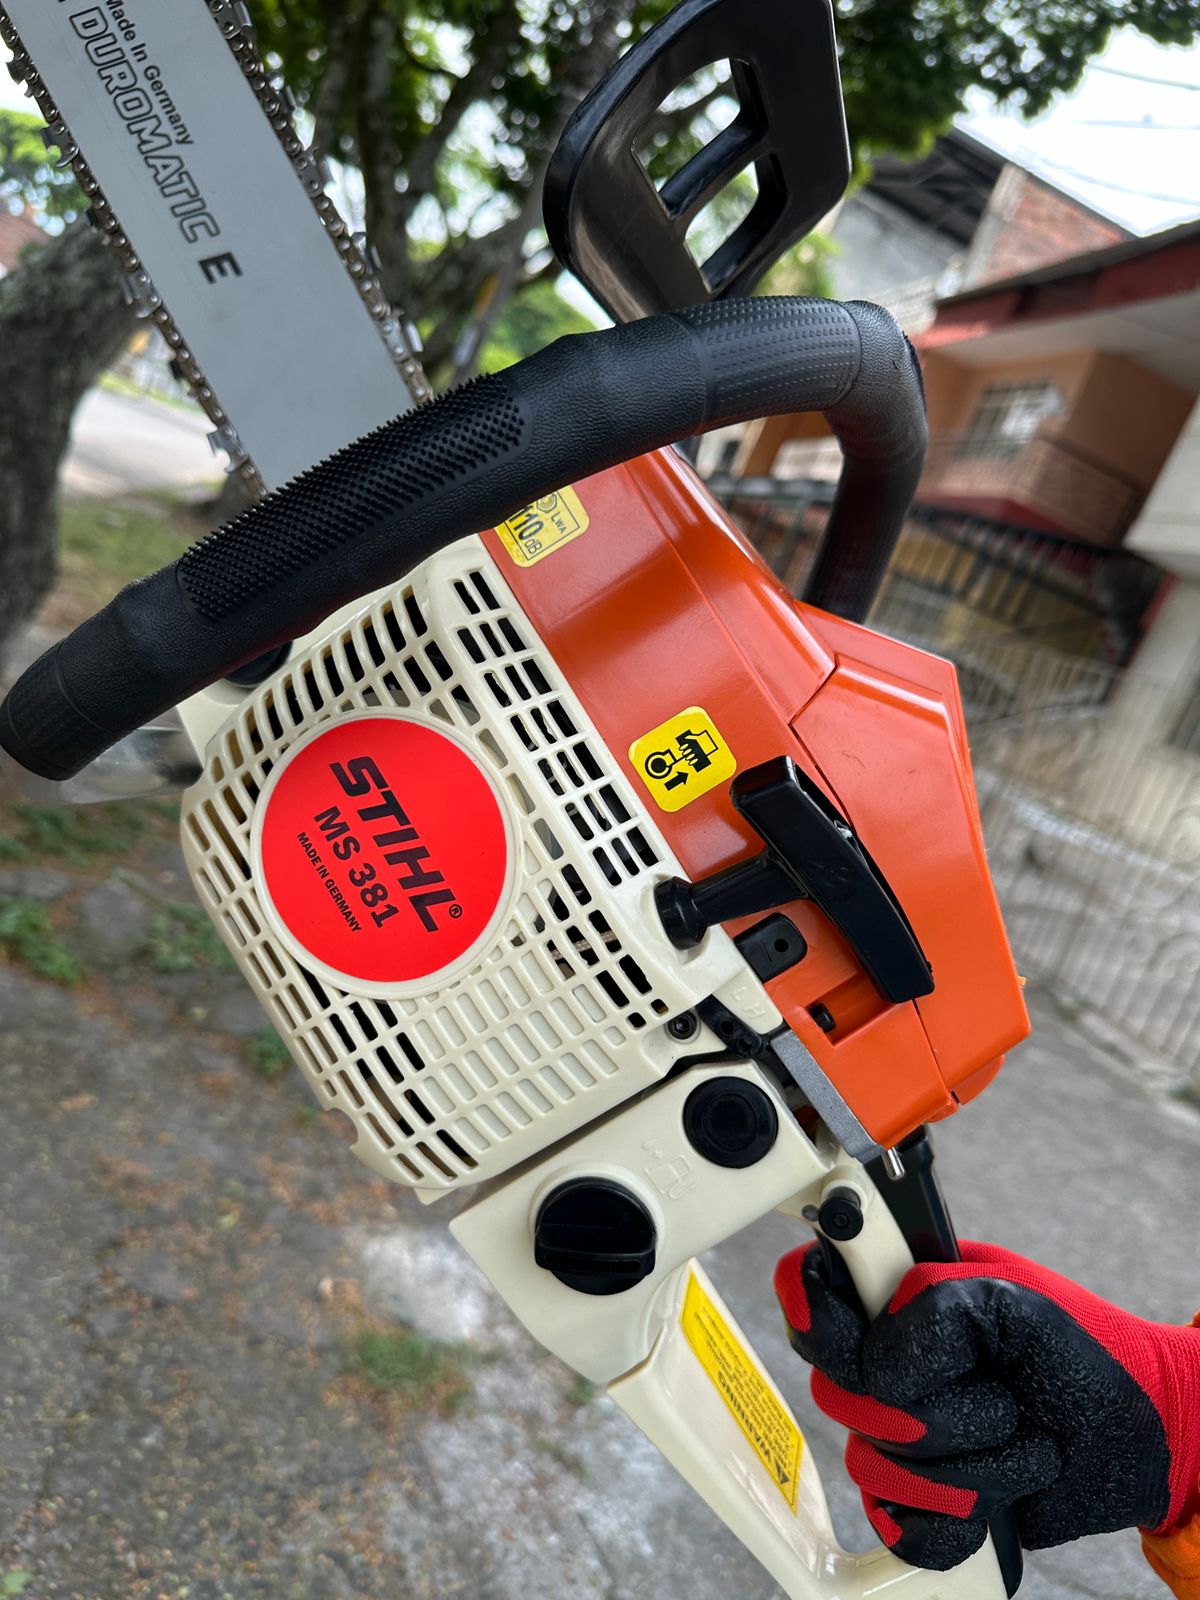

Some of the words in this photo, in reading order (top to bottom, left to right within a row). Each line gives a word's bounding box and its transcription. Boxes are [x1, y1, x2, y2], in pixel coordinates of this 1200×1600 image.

[68, 6, 221, 244] DUROMATIC
[198, 251, 244, 285] E
[130, 42, 148, 63] In
[143, 64, 195, 146] Germany
[524, 538, 543, 555] dB
[297, 832, 322, 866] MADE
[315, 864, 330, 880] IN
[324, 878, 363, 933] GERMANY
[313, 805, 361, 861] MS
[348, 862, 400, 929] 381
[329, 756, 456, 933] STIHL
[717, 1370, 772, 1463] WARNING
